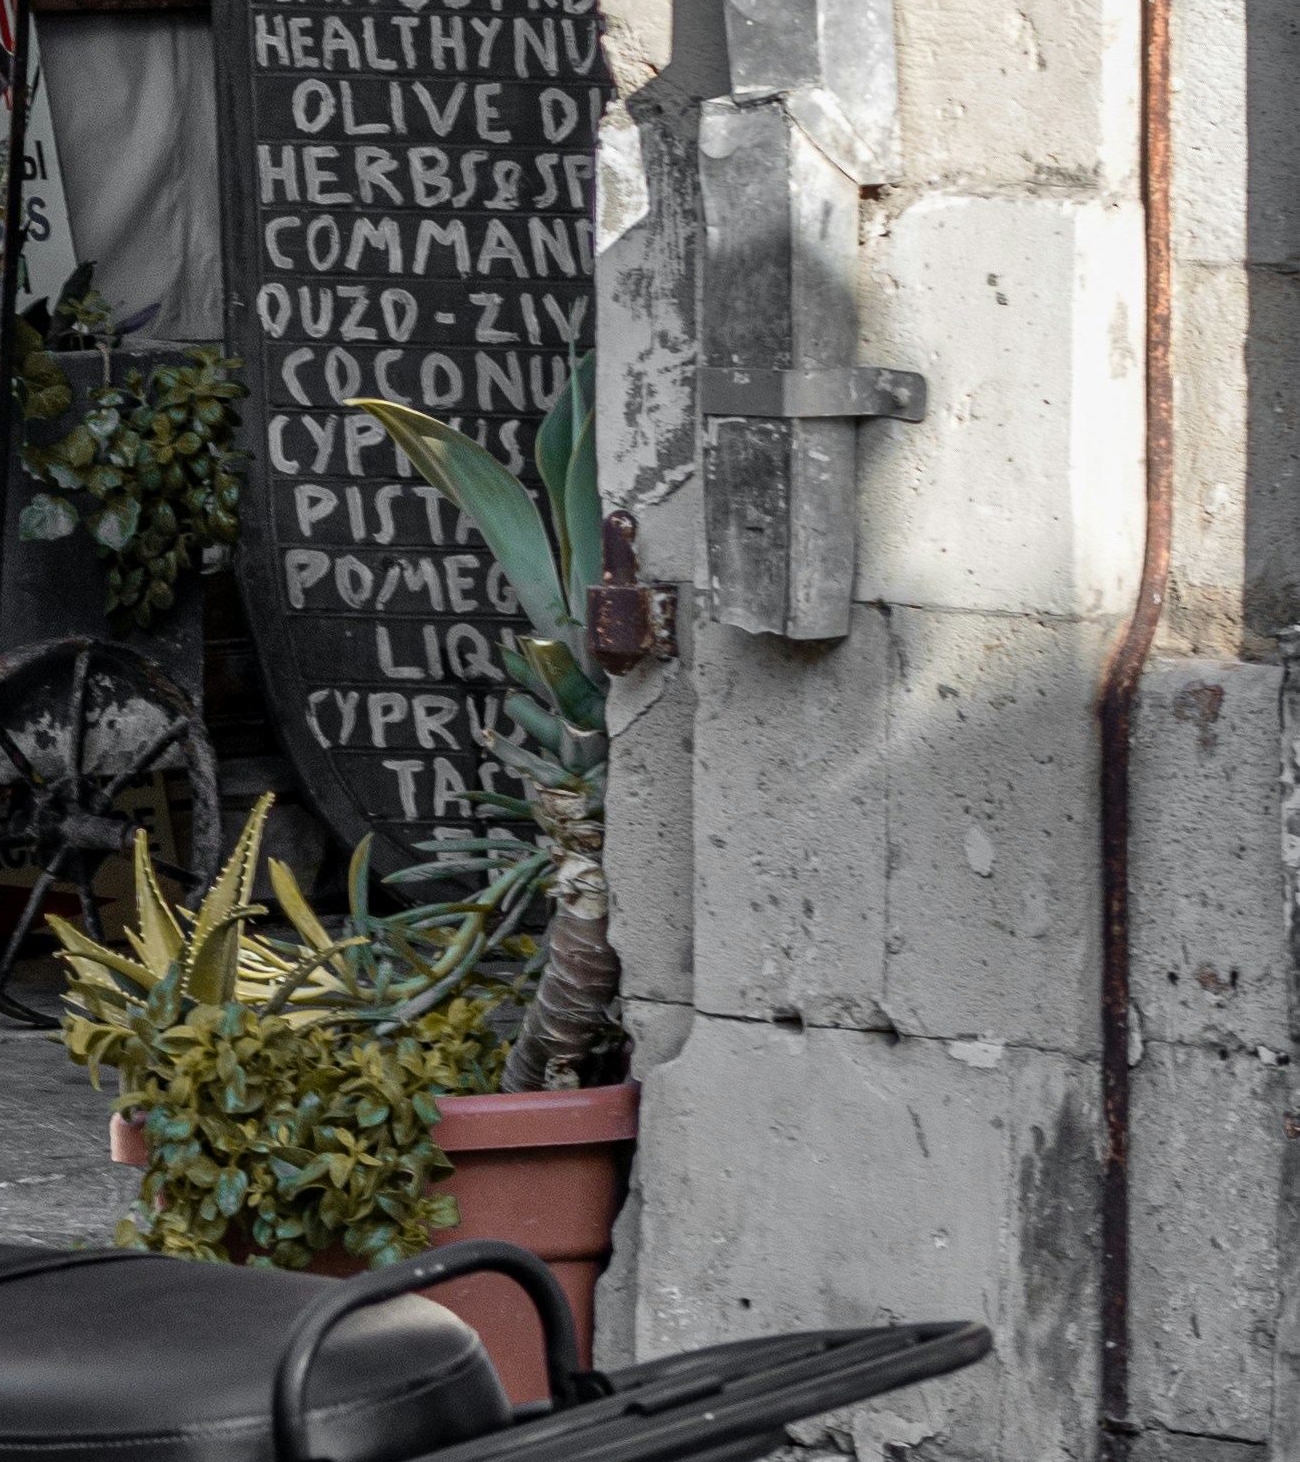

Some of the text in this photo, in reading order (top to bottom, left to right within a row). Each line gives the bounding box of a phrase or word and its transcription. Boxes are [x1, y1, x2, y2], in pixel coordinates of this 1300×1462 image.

[254, 14, 604, 79] HEALTHY NU
[291, 78, 513, 144] OLIVE
[256, 282, 418, 342] OUZO
[281, 346, 581, 412] COCONU
[268, 414, 525, 476] CYPS
[305, 688, 528, 750] CYPRU
